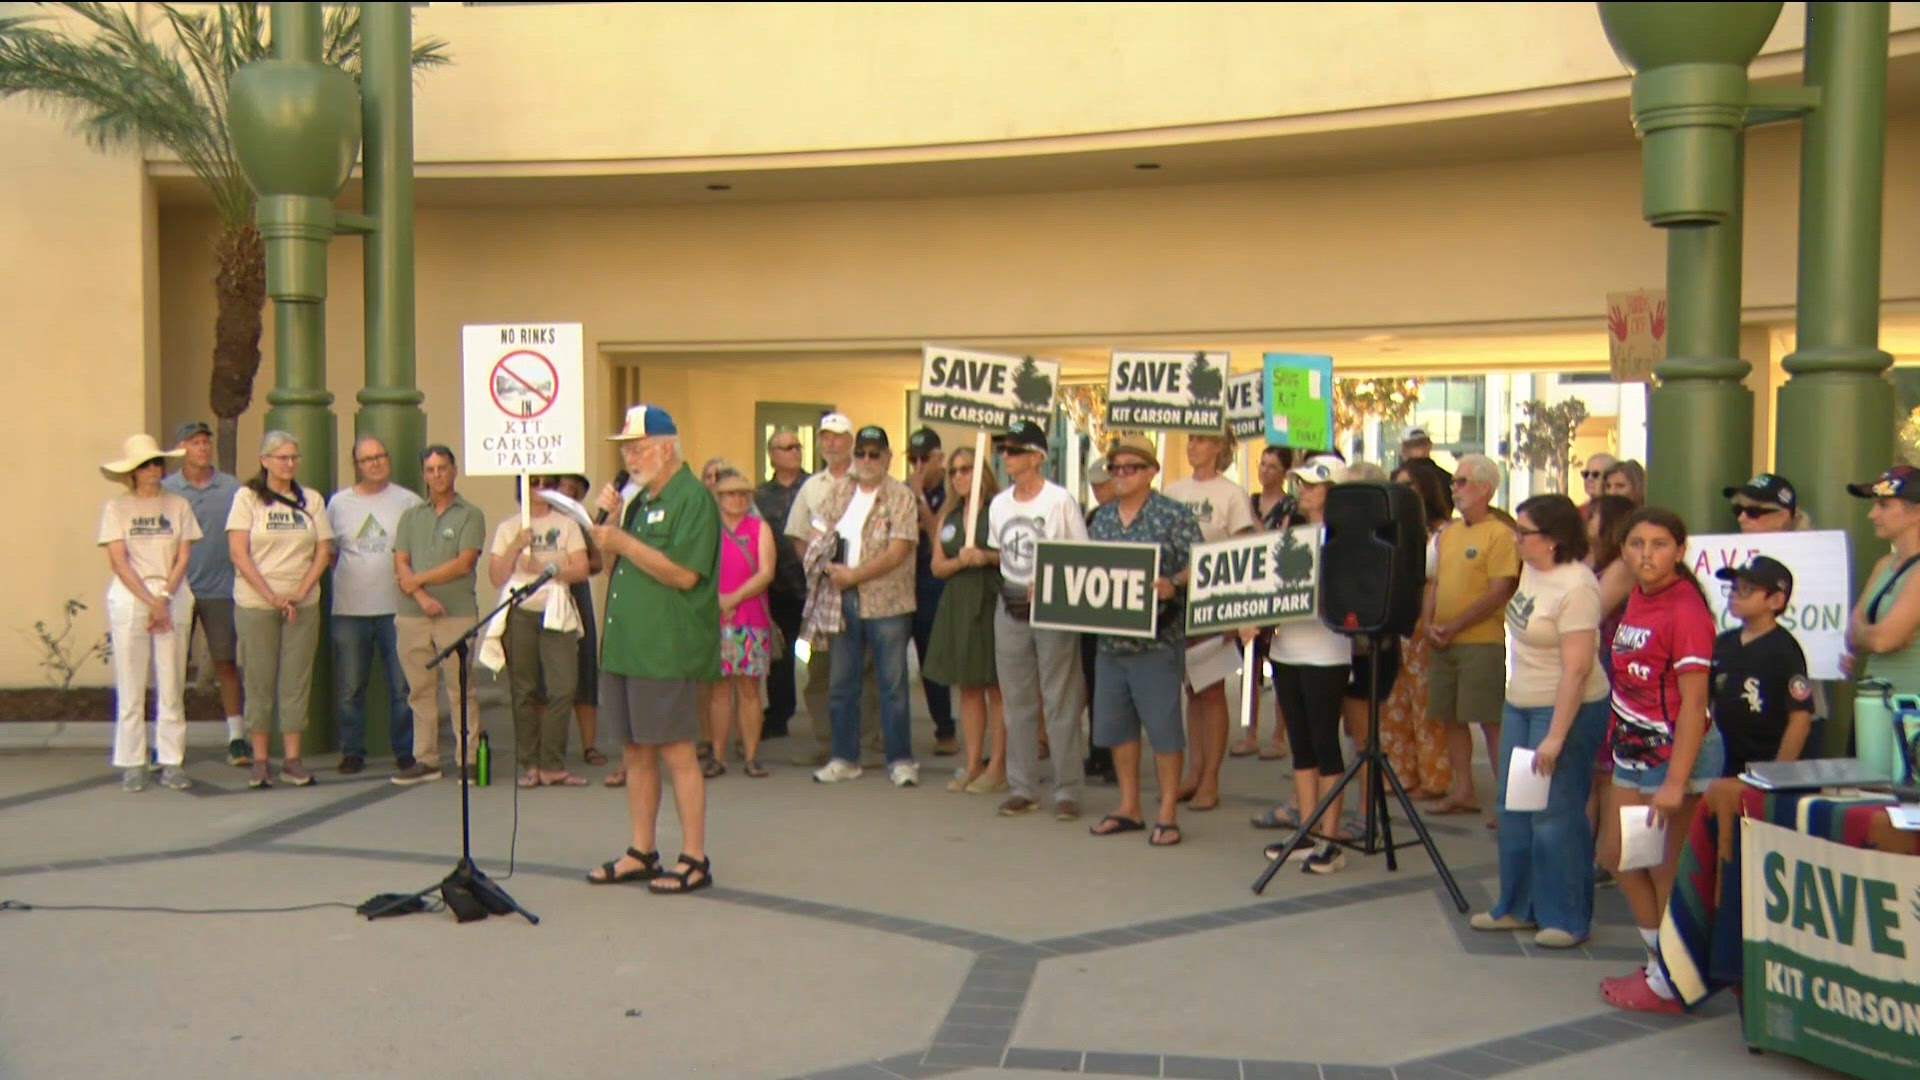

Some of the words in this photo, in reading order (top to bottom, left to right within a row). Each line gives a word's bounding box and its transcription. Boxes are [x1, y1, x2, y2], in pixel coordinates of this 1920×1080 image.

[501, 329, 514, 344] NO
[520, 328, 555, 344] RINKS
[930, 356, 1007, 395] SAVE
[1116, 361, 1181, 393] SAVE
[521, 400, 532, 417] IN
[924, 402, 947, 418] KIT
[950, 404, 1005, 426] CARSON
[1111, 406, 1130, 422] KIT
[1133, 408, 1180, 424] CARSON
[1185, 409, 1218, 426] PARK
[505, 421, 543, 434] KIT
[483, 434, 562, 451] CARSON
[498, 452, 553, 466] PARK
[268, 511, 290, 521] SAVE
[1197, 546, 1267, 589] SAVE
[1042, 563, 1053, 604] I
[1064, 564, 1146, 611] VOTE
[1194, 606, 1214, 624] KIT
[1217, 597, 1268, 620] CARSON
[1272, 592, 1310, 612] PARK
[1764, 851, 1906, 959] SAVE
[1764, 960, 1804, 1000] KIT
[1811, 977, 1920, 1036] CARSON
